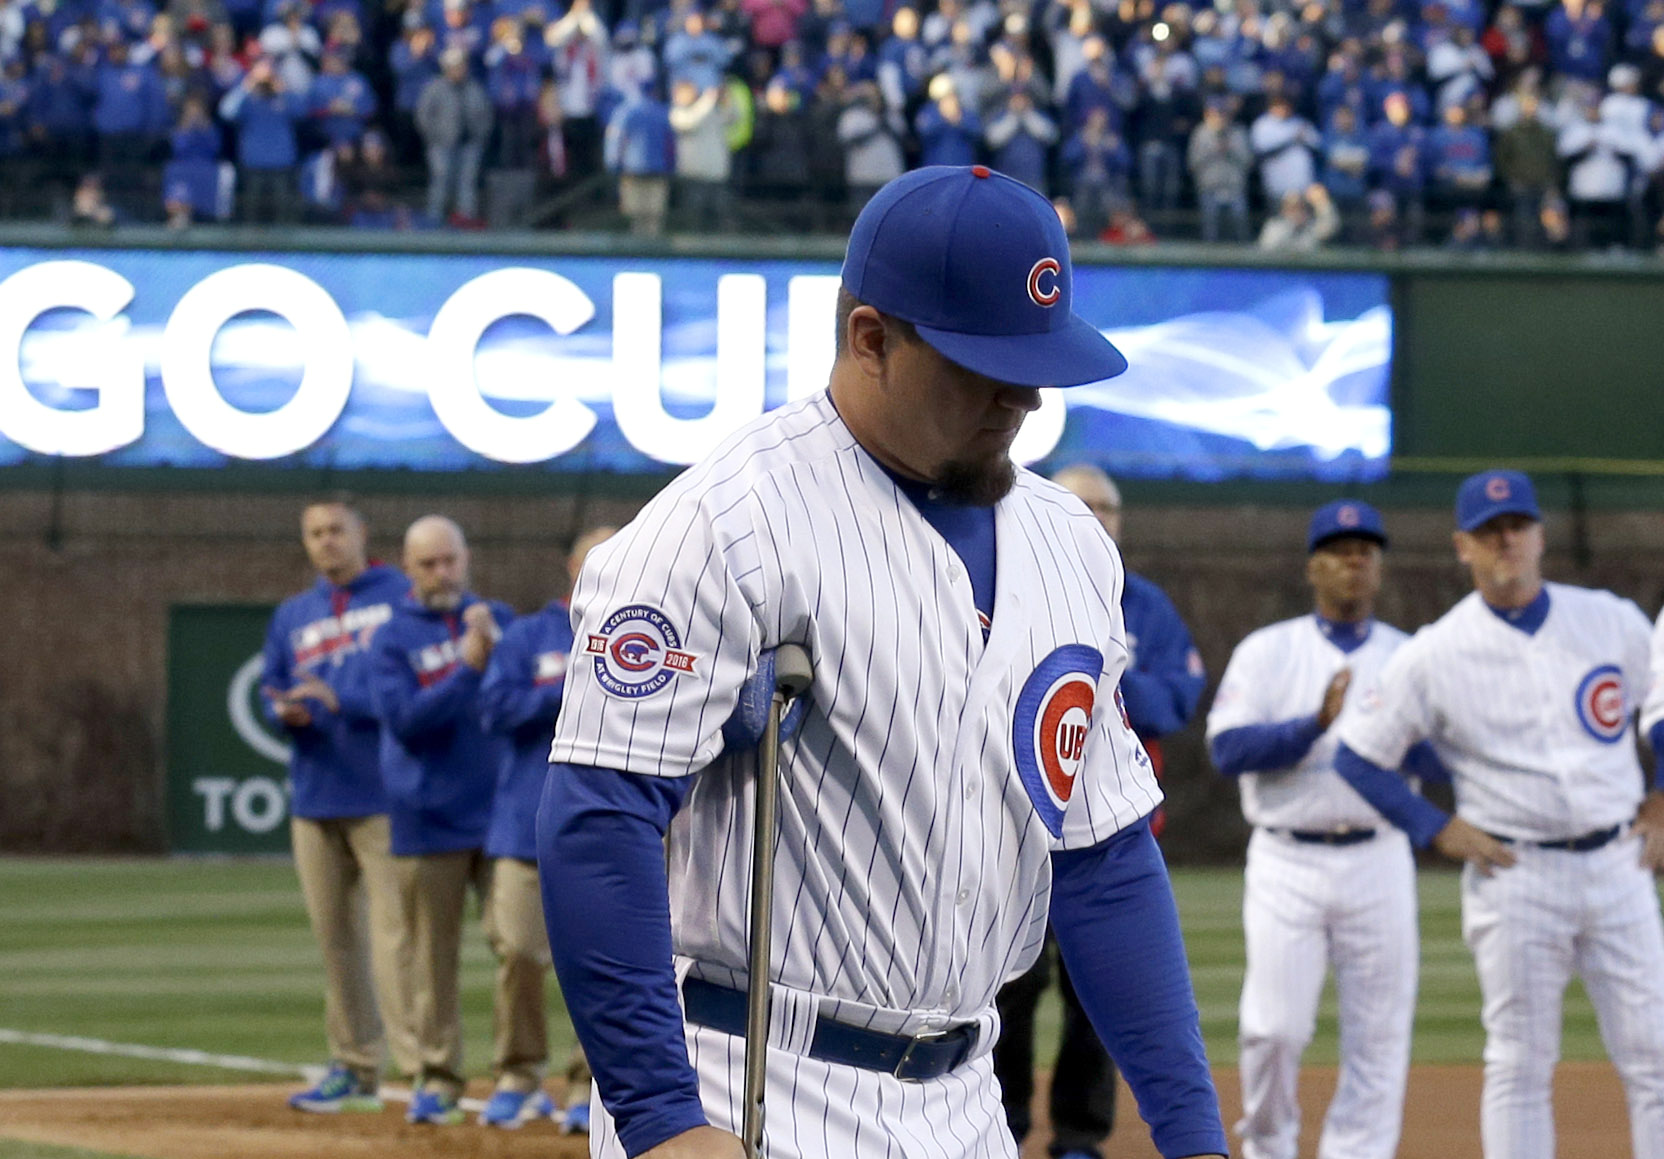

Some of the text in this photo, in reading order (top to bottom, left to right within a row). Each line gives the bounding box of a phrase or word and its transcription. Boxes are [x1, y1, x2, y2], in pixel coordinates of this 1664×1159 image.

[1026, 257, 1061, 309] C
[0, 260, 1066, 466] GO CU
[604, 609, 677, 647] A CENTURY OF CUBS
[596, 662, 667, 694] AT WRIGLEY FIELD
[666, 653, 689, 668] 2016
[192, 777, 294, 833] TO
